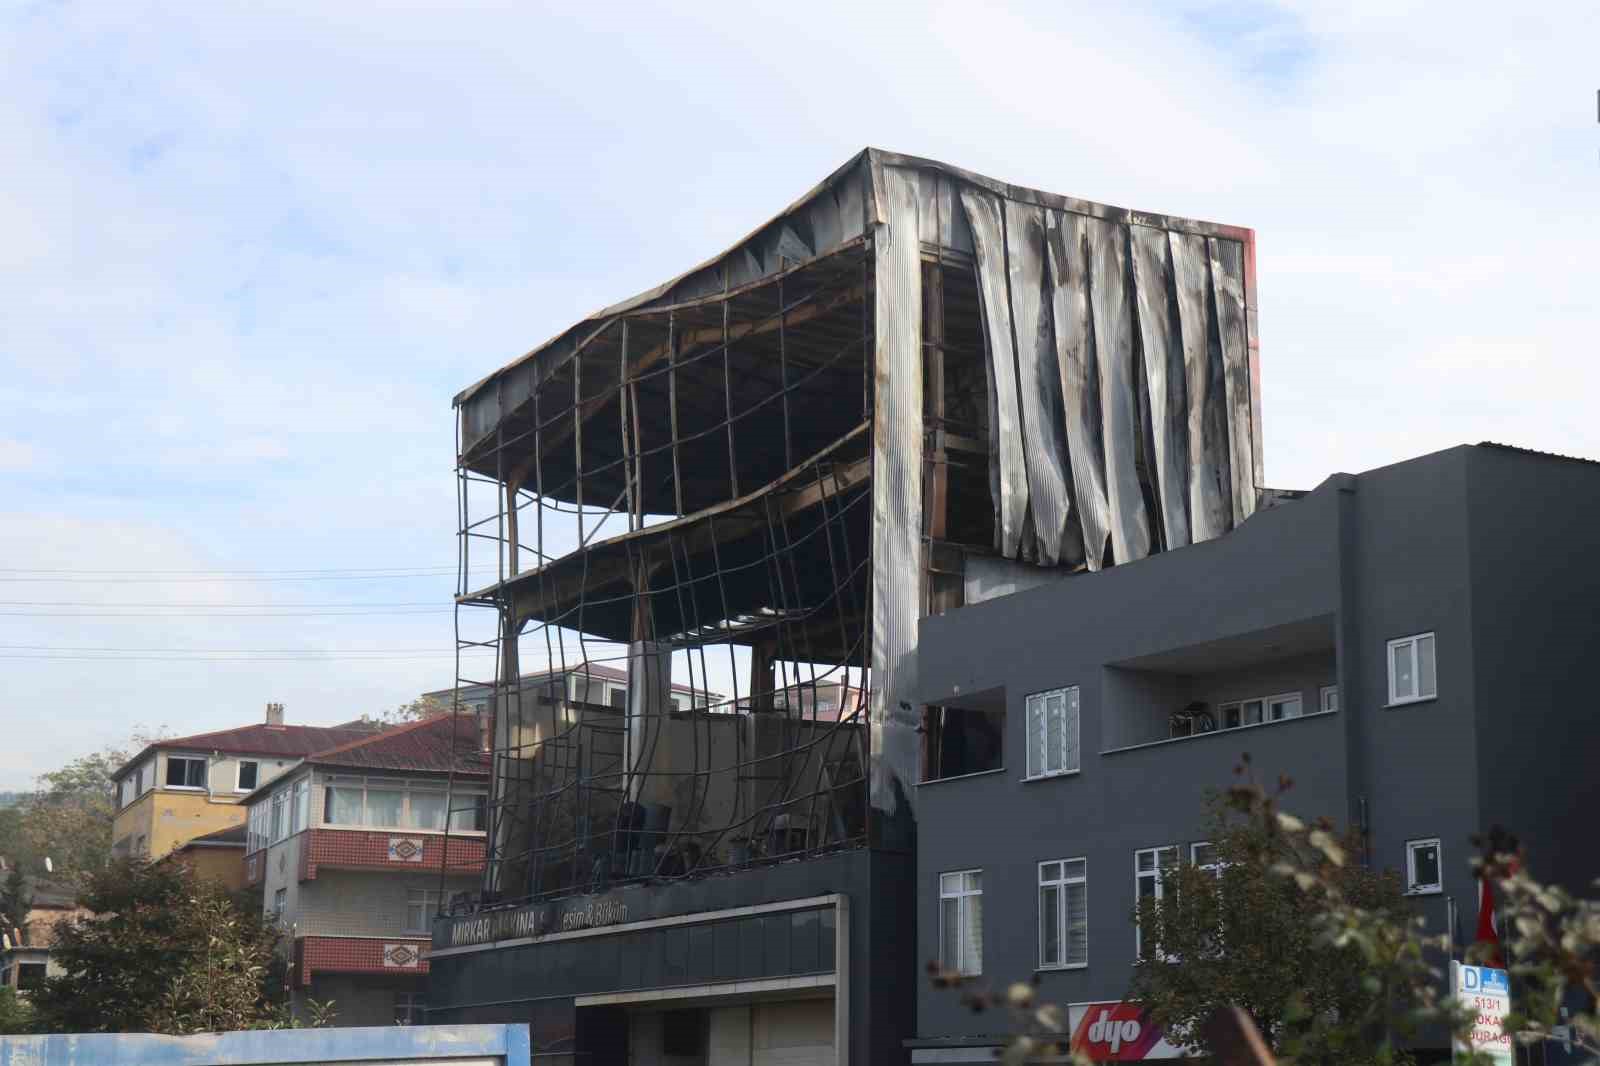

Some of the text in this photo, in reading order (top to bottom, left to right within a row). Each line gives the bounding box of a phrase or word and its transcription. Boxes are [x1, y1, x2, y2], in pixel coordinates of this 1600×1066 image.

[452, 918, 489, 944] MIRKAR
[1465, 968, 1478, 988] D
[1089, 1010, 1141, 1053] dyo
